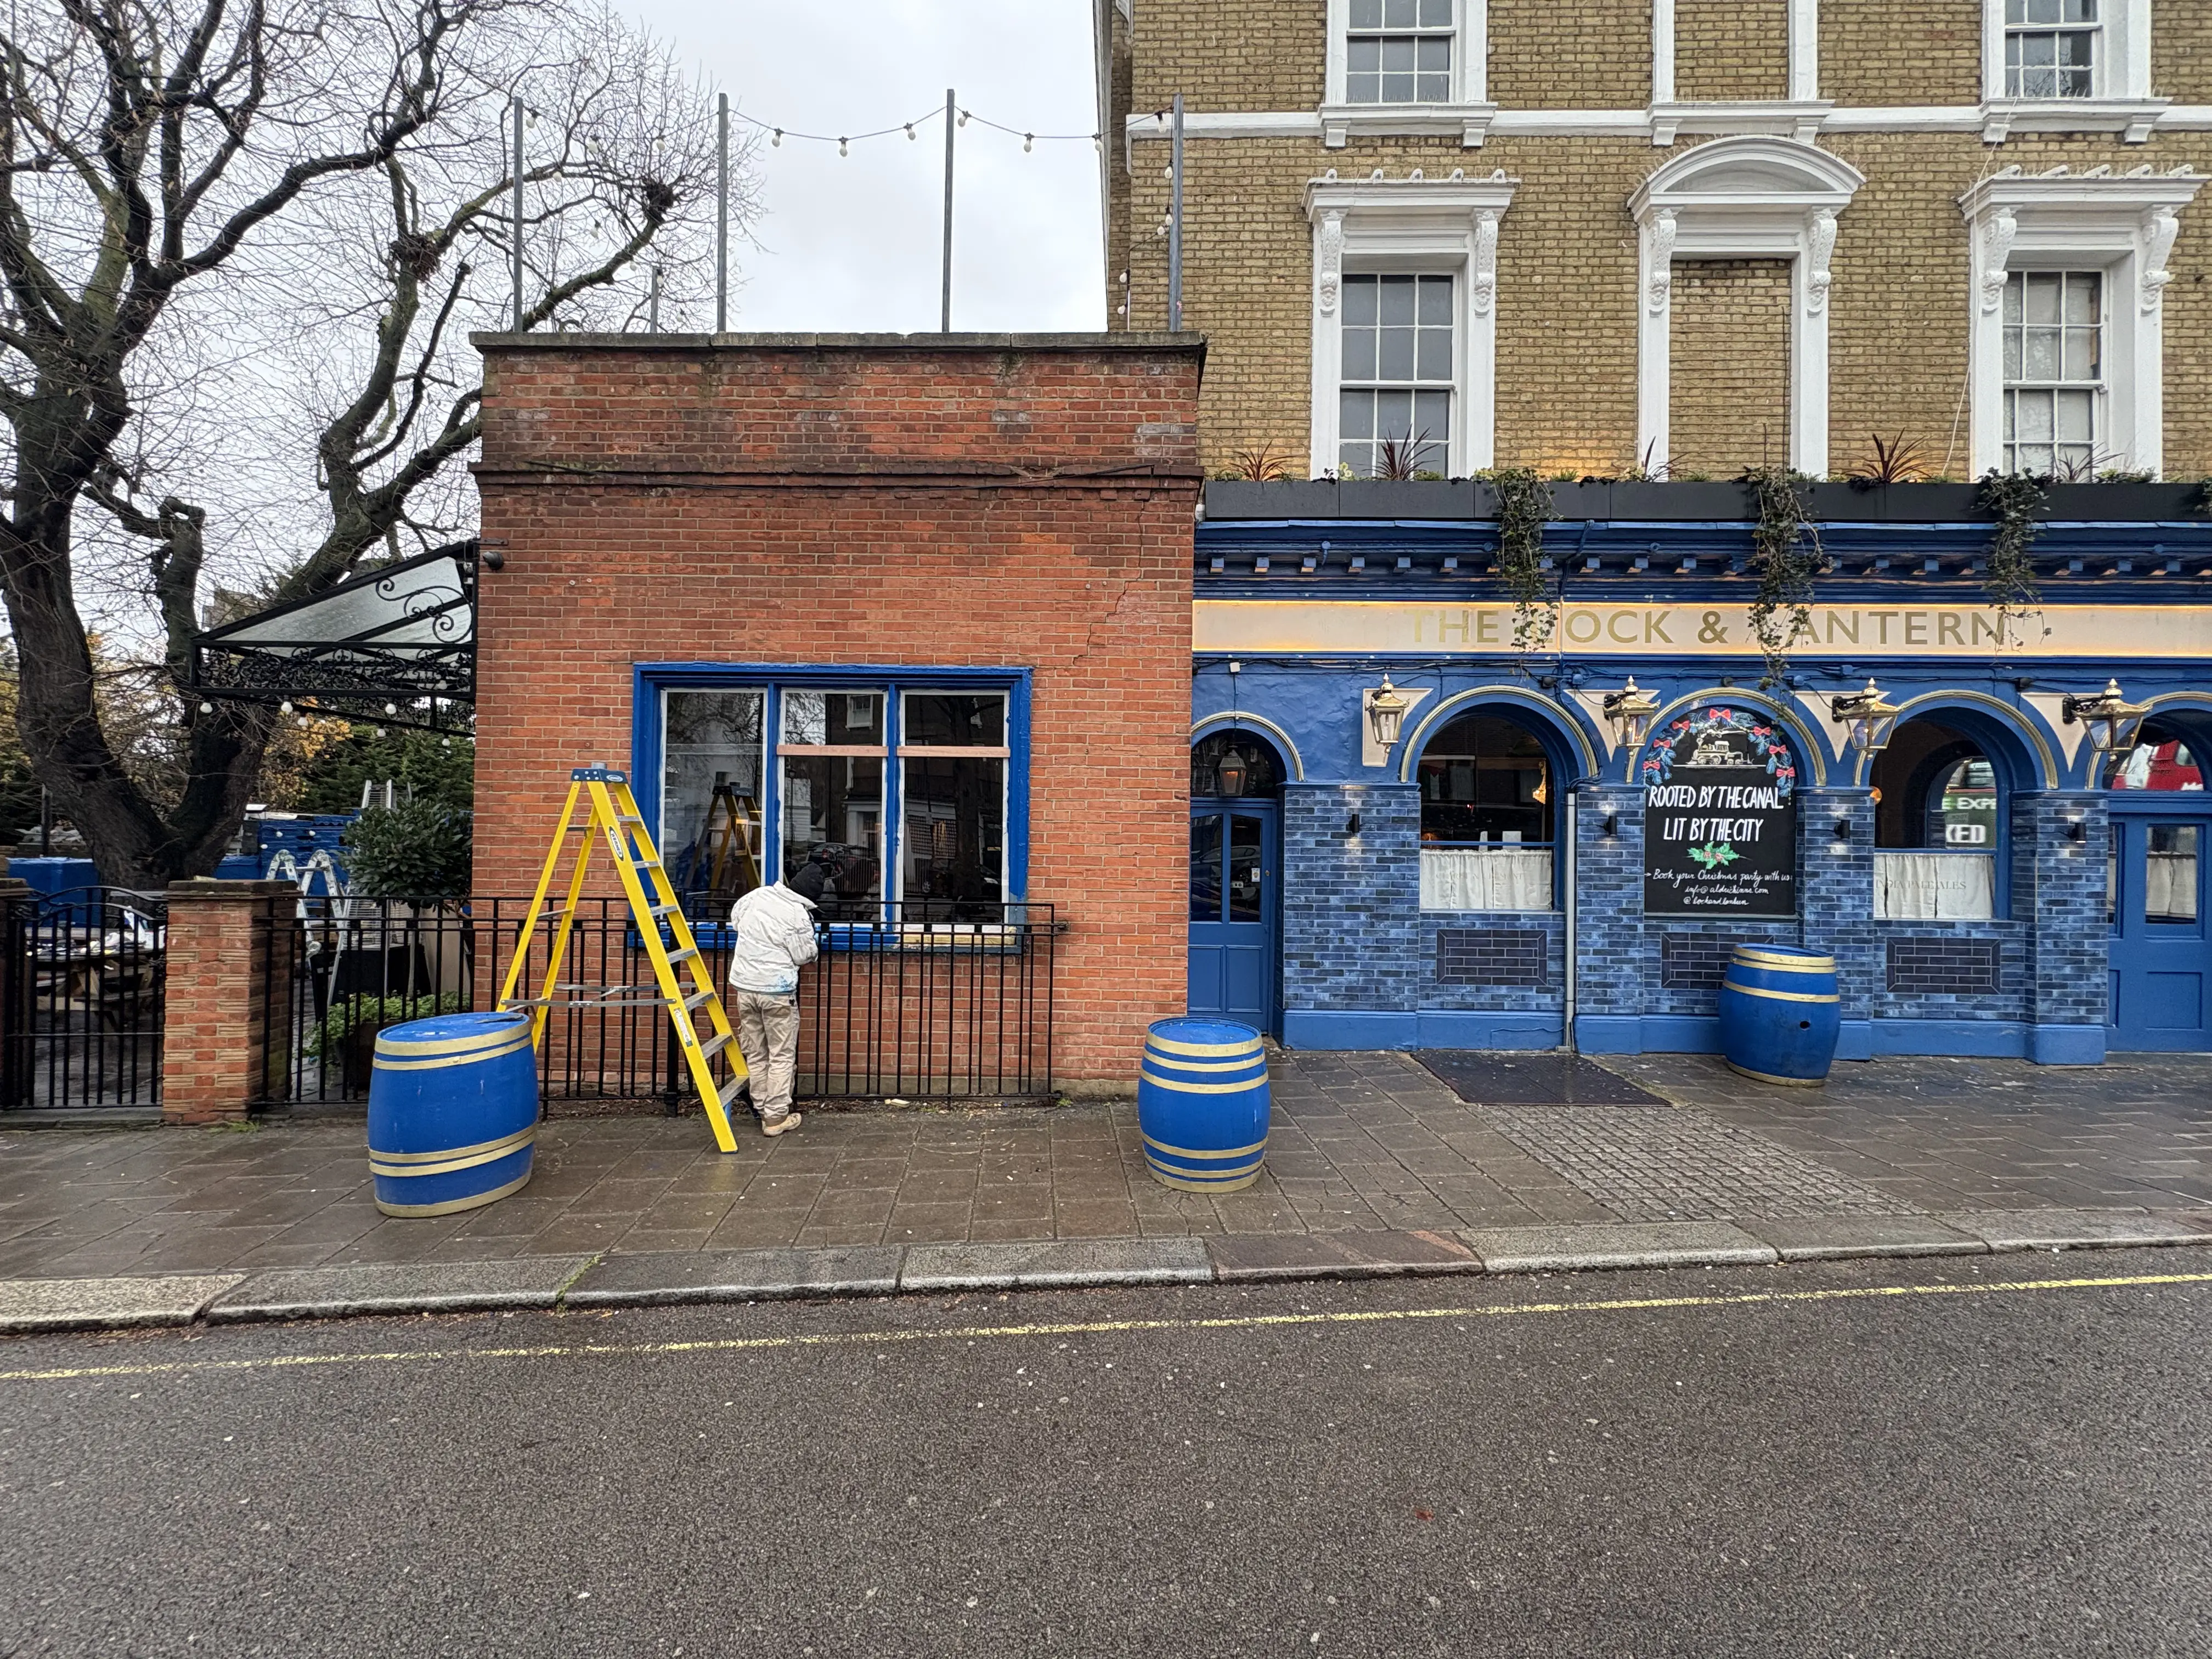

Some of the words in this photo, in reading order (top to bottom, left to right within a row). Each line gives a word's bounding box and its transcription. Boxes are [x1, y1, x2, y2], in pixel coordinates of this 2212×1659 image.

[1402, 609, 1499, 643] THE
[1698, 611, 1729, 644] &
[1759, 610, 2004, 645] ANTERN
[1649, 786, 1696, 808] ROOTED
[1698, 786, 1719, 808] BY
[1663, 818, 1687, 840] LIT
[1689, 818, 1709, 841] BY
[611, 833, 622, 855] WERNER
[1652, 868, 1674, 879] Book
[1673, 872, 1695, 888] your
[1698, 870, 1737, 880] Christmas
[1740, 870, 1763, 888] party
[1764, 870, 1780, 881] with
[1937, 881, 1966, 890] ALES
